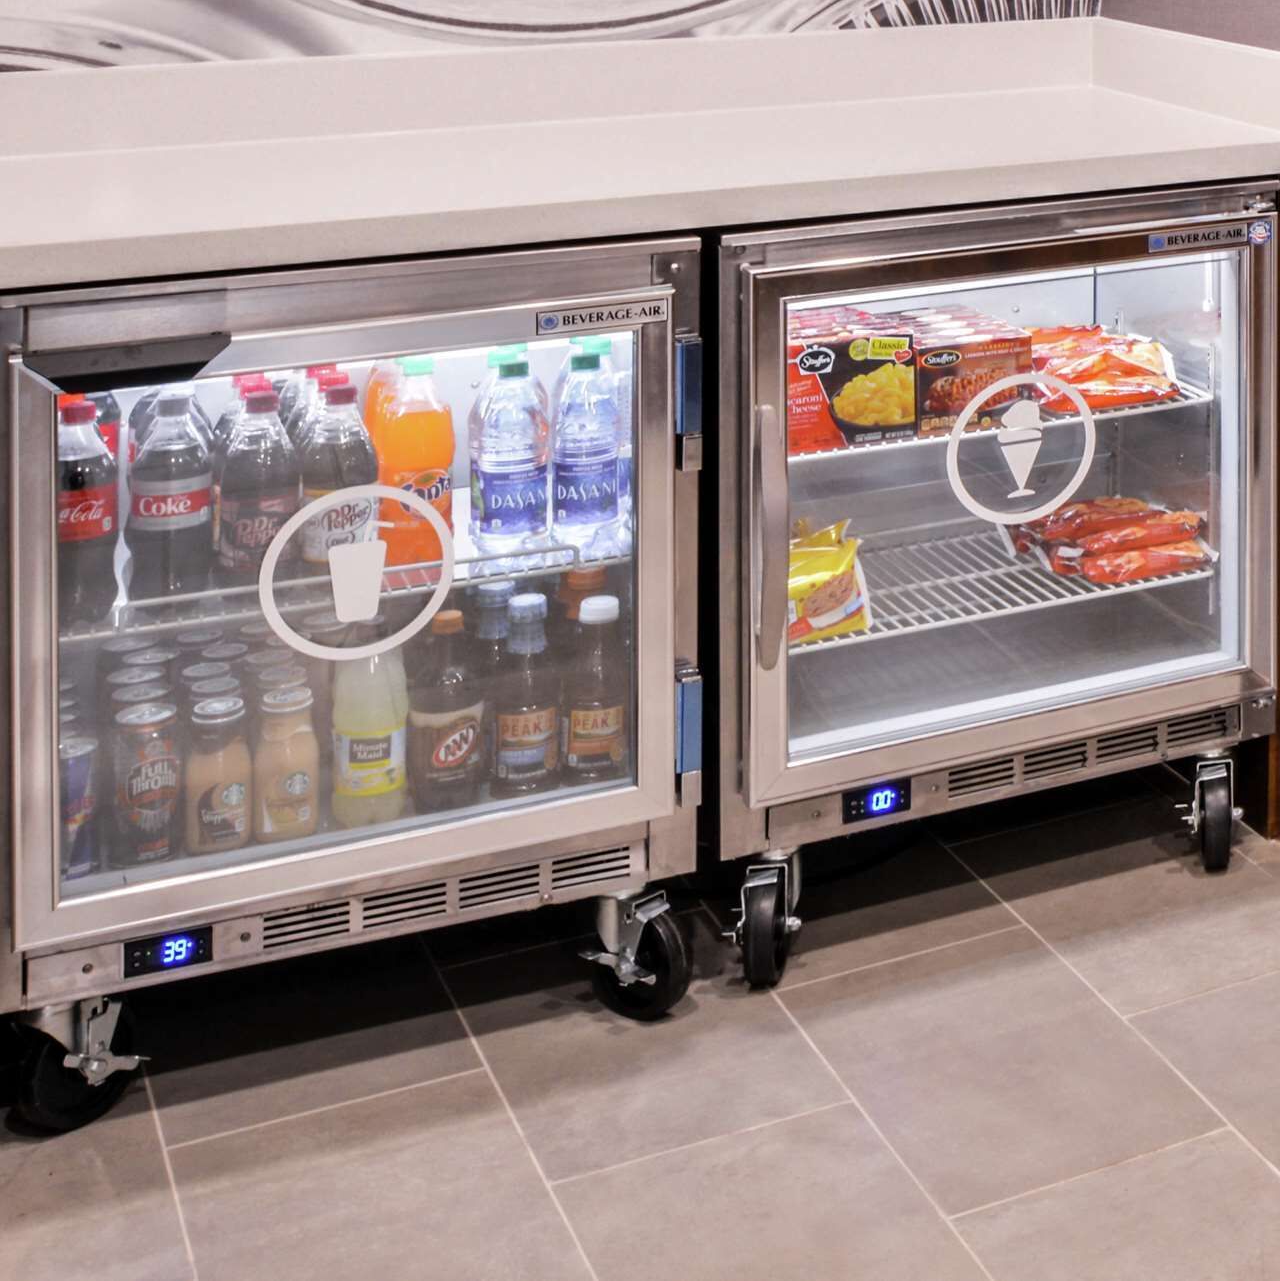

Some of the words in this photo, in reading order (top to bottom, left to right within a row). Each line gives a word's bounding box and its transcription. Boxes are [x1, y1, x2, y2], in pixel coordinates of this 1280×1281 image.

[792, 402, 822, 414] heese
[491, 490, 546, 509] DASAN
[557, 479, 617, 502] DASANI
[139, 498, 192, 516] Coke
[327, 505, 369, 532] Pepper
[503, 721, 543, 737] PEAK
[574, 718, 610, 732] PEAK
